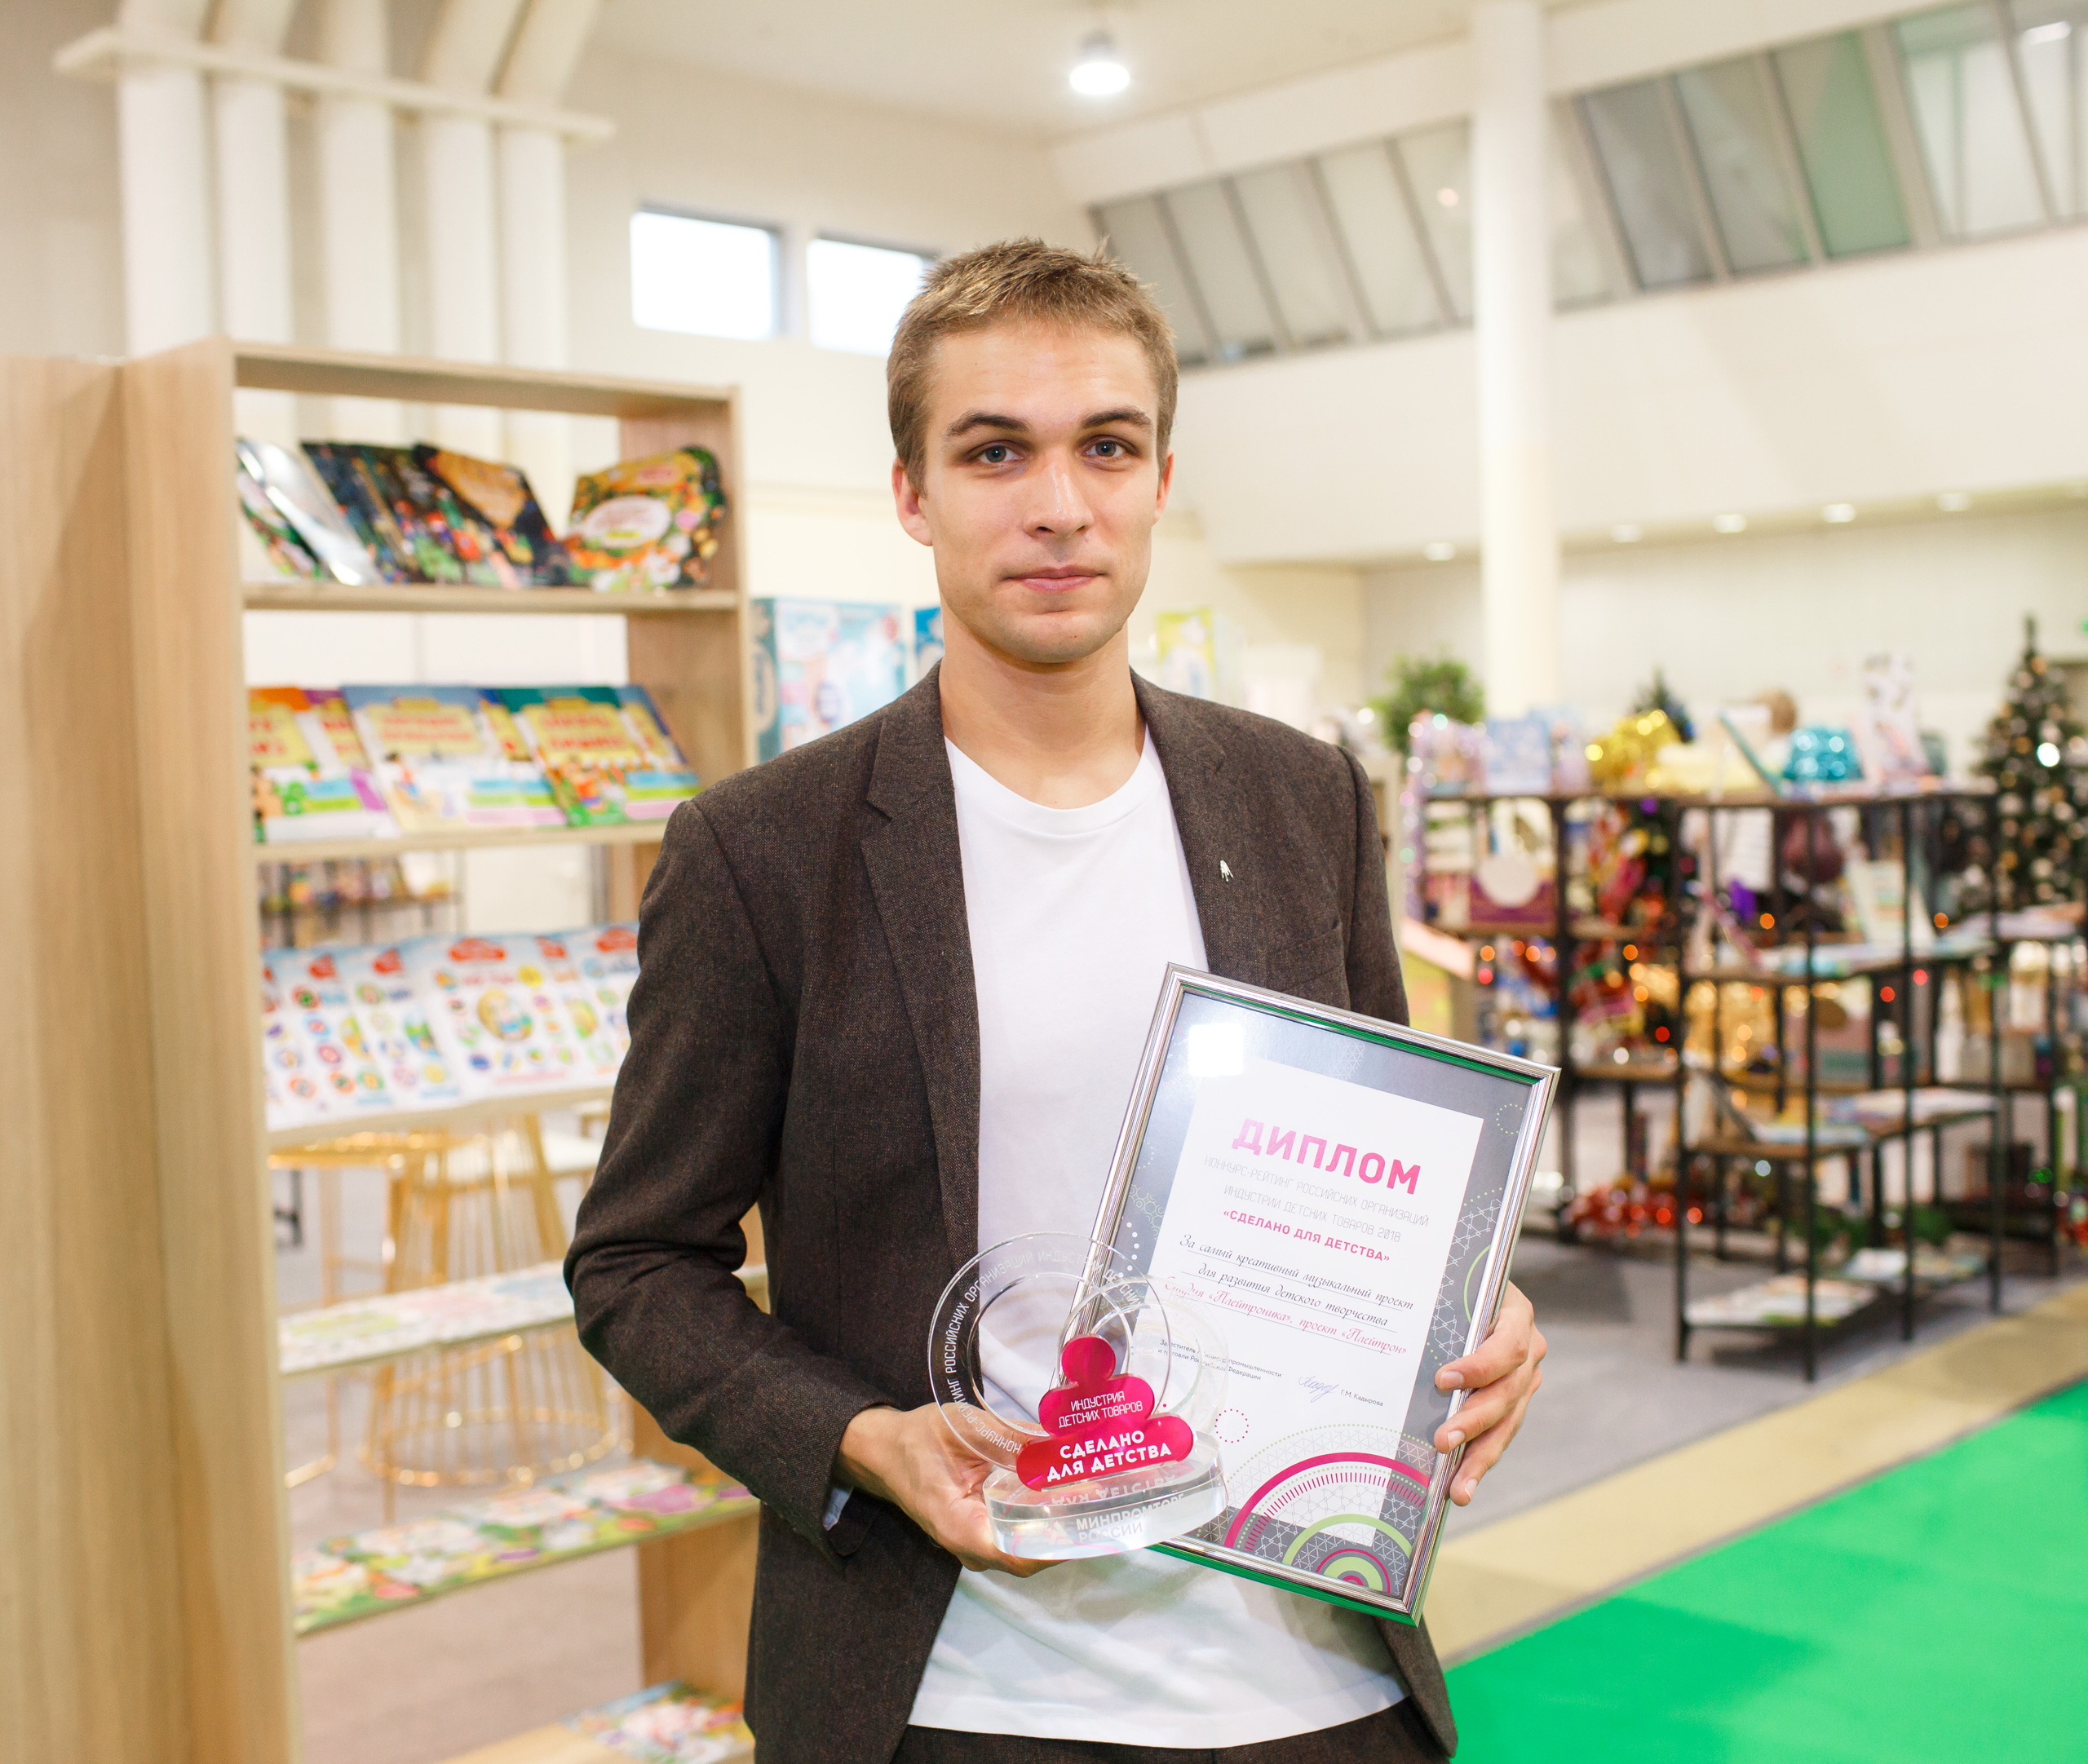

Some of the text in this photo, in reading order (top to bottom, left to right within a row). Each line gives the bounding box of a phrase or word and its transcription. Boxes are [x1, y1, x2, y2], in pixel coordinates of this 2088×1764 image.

[1231, 1118, 1421, 1195] ДИПЛОМ
[1224, 1184, 1400, 1242] ИНДУСТРИИ ДЕТСКИХ ТОВАРОВ 2018
[1296, 1180, 1357, 1207] РОССИЙСКИХ
[1360, 1197, 1429, 1227] ОРГАНИЗАЦИЙ
[1223, 1208, 1390, 1262] «СДЕЛАНО ДЛЯ ДЕТСТВА»
[1179, 1234, 1413, 1312] За самый креативный музыкальный проект
[1199, 1264, 1386, 1329] для развития детского творчества
[1298, 1319, 1336, 1338] проект
[1059, 1401, 1143, 1428] ДЕТСКИХ ТОВАРОВ
[1071, 1390, 1125, 1412] ИНДУСТРИЯ
[1340, 1389, 1383, 1408] Г.М. Кадырова
[1047, 1443, 1172, 1482] ДЛЯ ДЕТСТВА
[1059, 1430, 1144, 1459] СДЕЛАНО
[1078, 1520, 1143, 1543] РОССИИ
